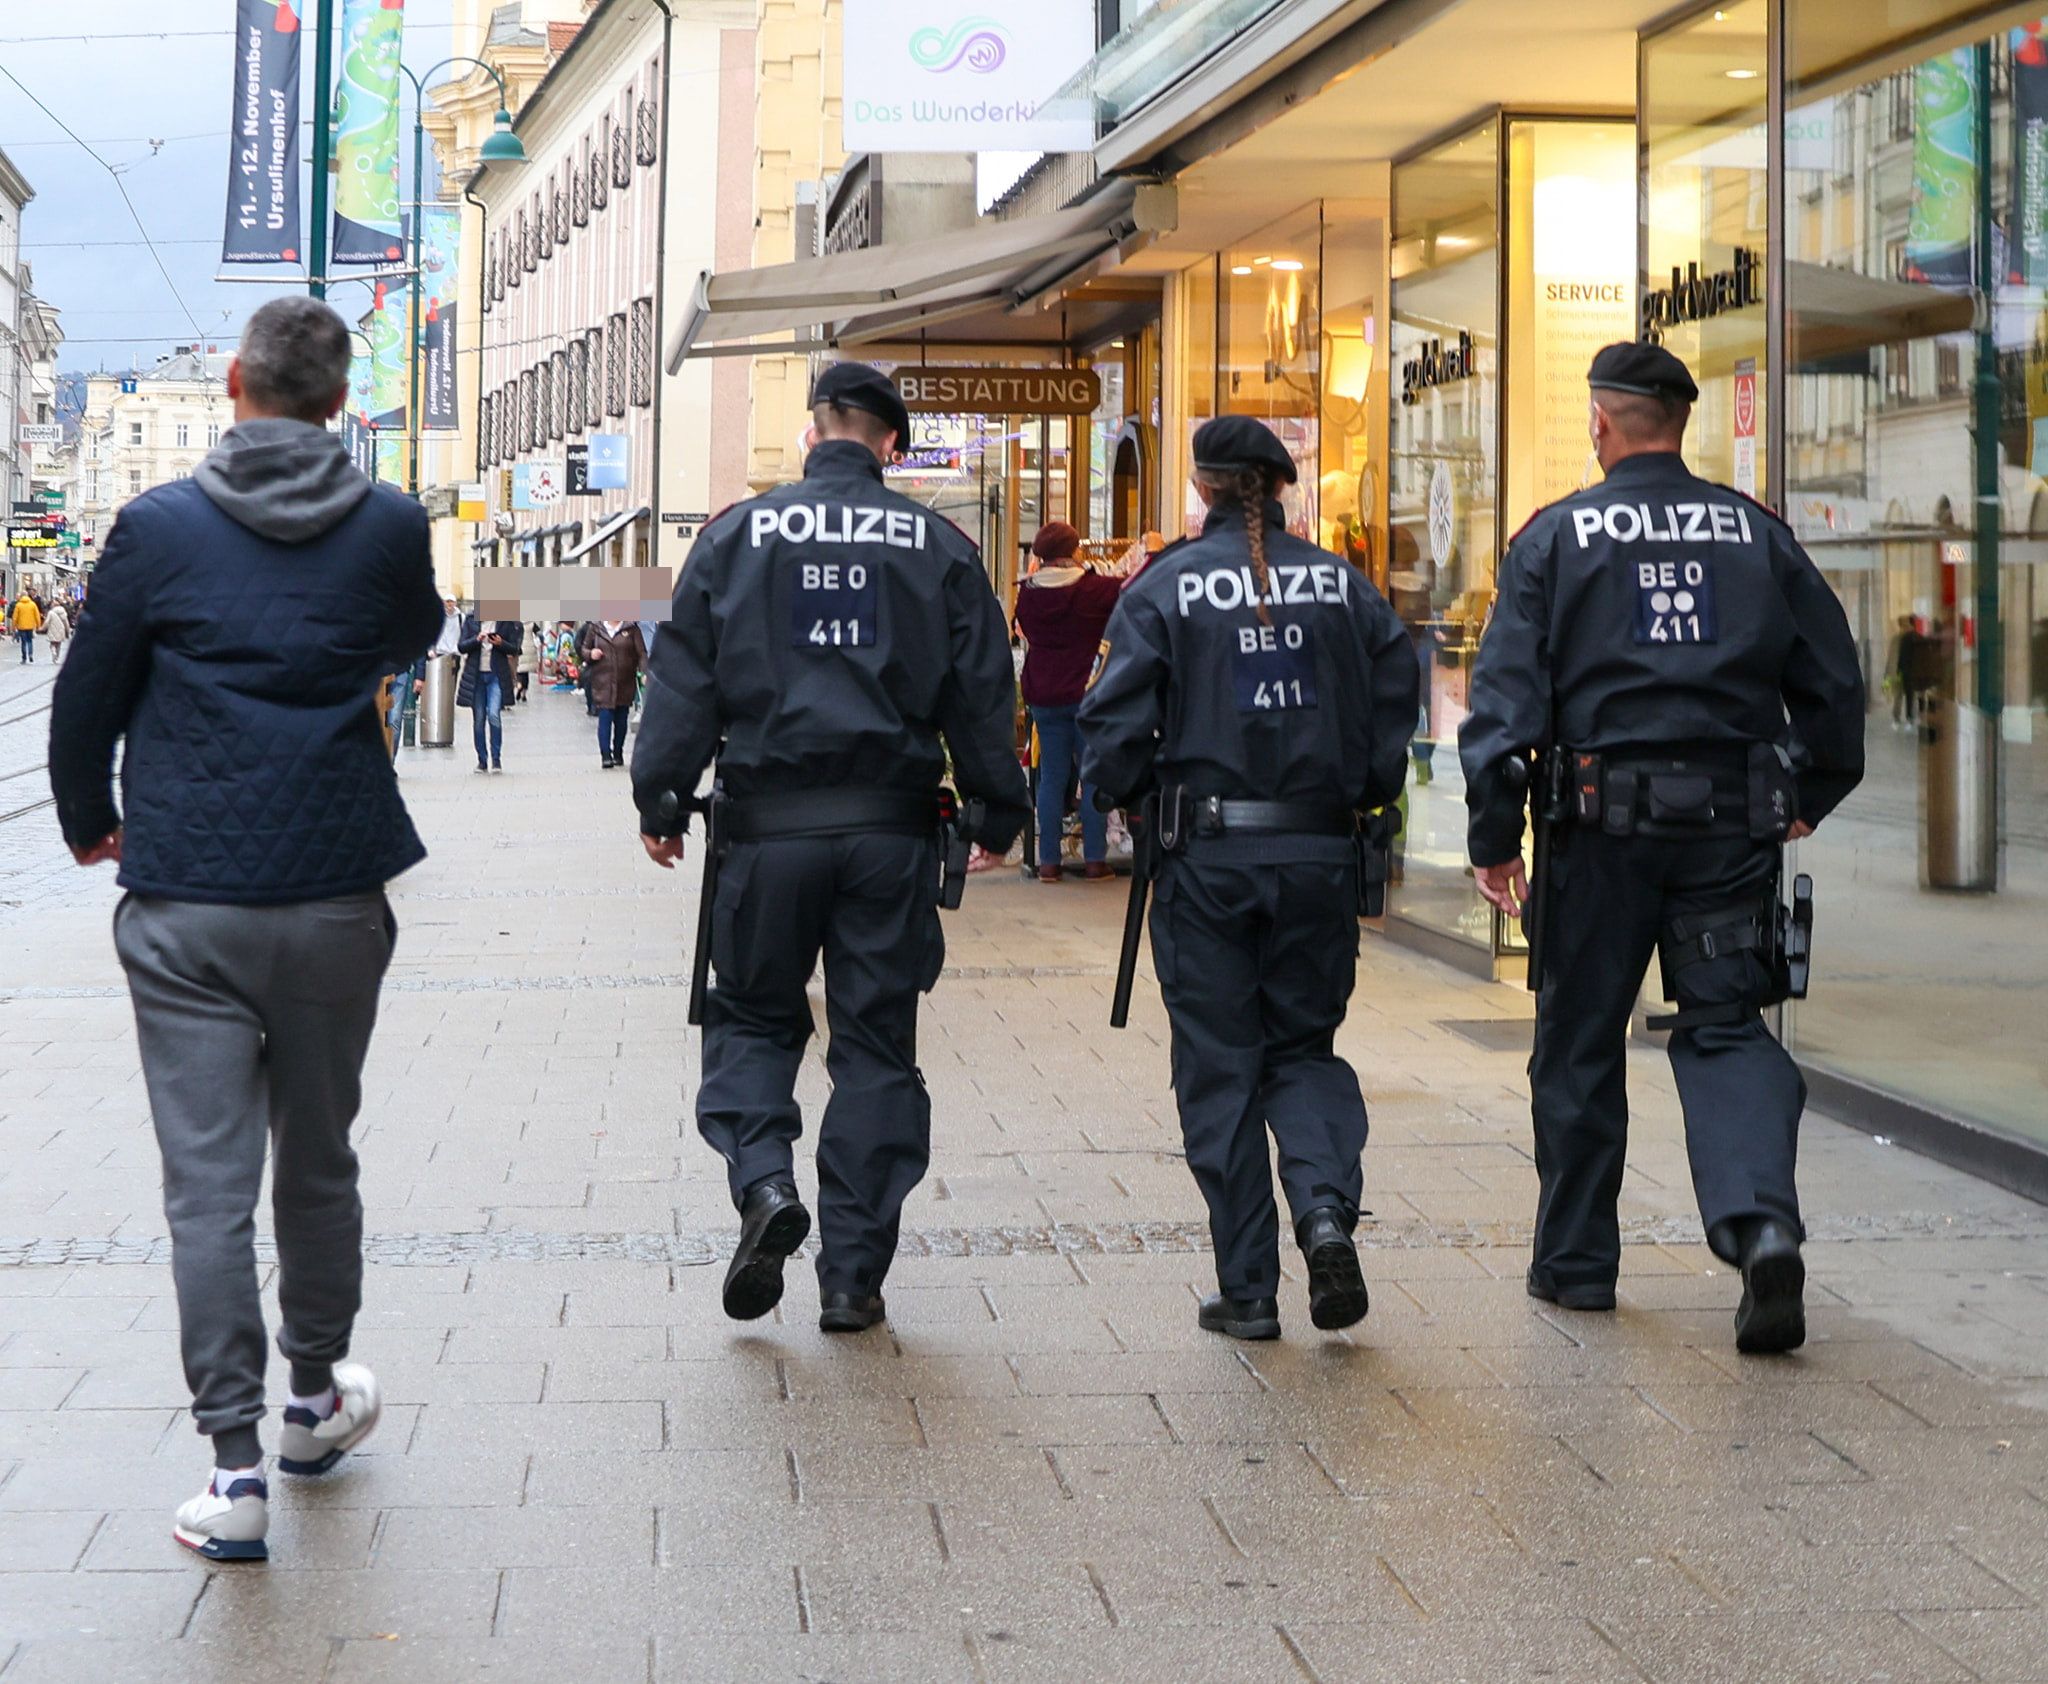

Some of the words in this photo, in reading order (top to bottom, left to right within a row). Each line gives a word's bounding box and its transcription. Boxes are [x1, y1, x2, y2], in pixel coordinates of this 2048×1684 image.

[243, 26, 262, 136] November
[854, 100, 902, 122] Das
[242, 142, 259, 176] 12.
[267, 88, 286, 230] Ursulinenhof
[240, 196, 258, 230] 11.
[1547, 284, 1625, 302] SERVICE
[900, 376, 1091, 404] BESTATTUNG
[751, 503, 926, 550] POLIZEI
[1572, 503, 1752, 548] POLIZEI
[802, 564, 840, 590] BE
[1638, 562, 1677, 589] BE
[1177, 564, 1350, 617] POLIZEI
[809, 619, 859, 646] 411
[1238, 626, 1277, 654] BE
[1650, 614, 1700, 643] 411
[1254, 679, 1303, 709] 411
